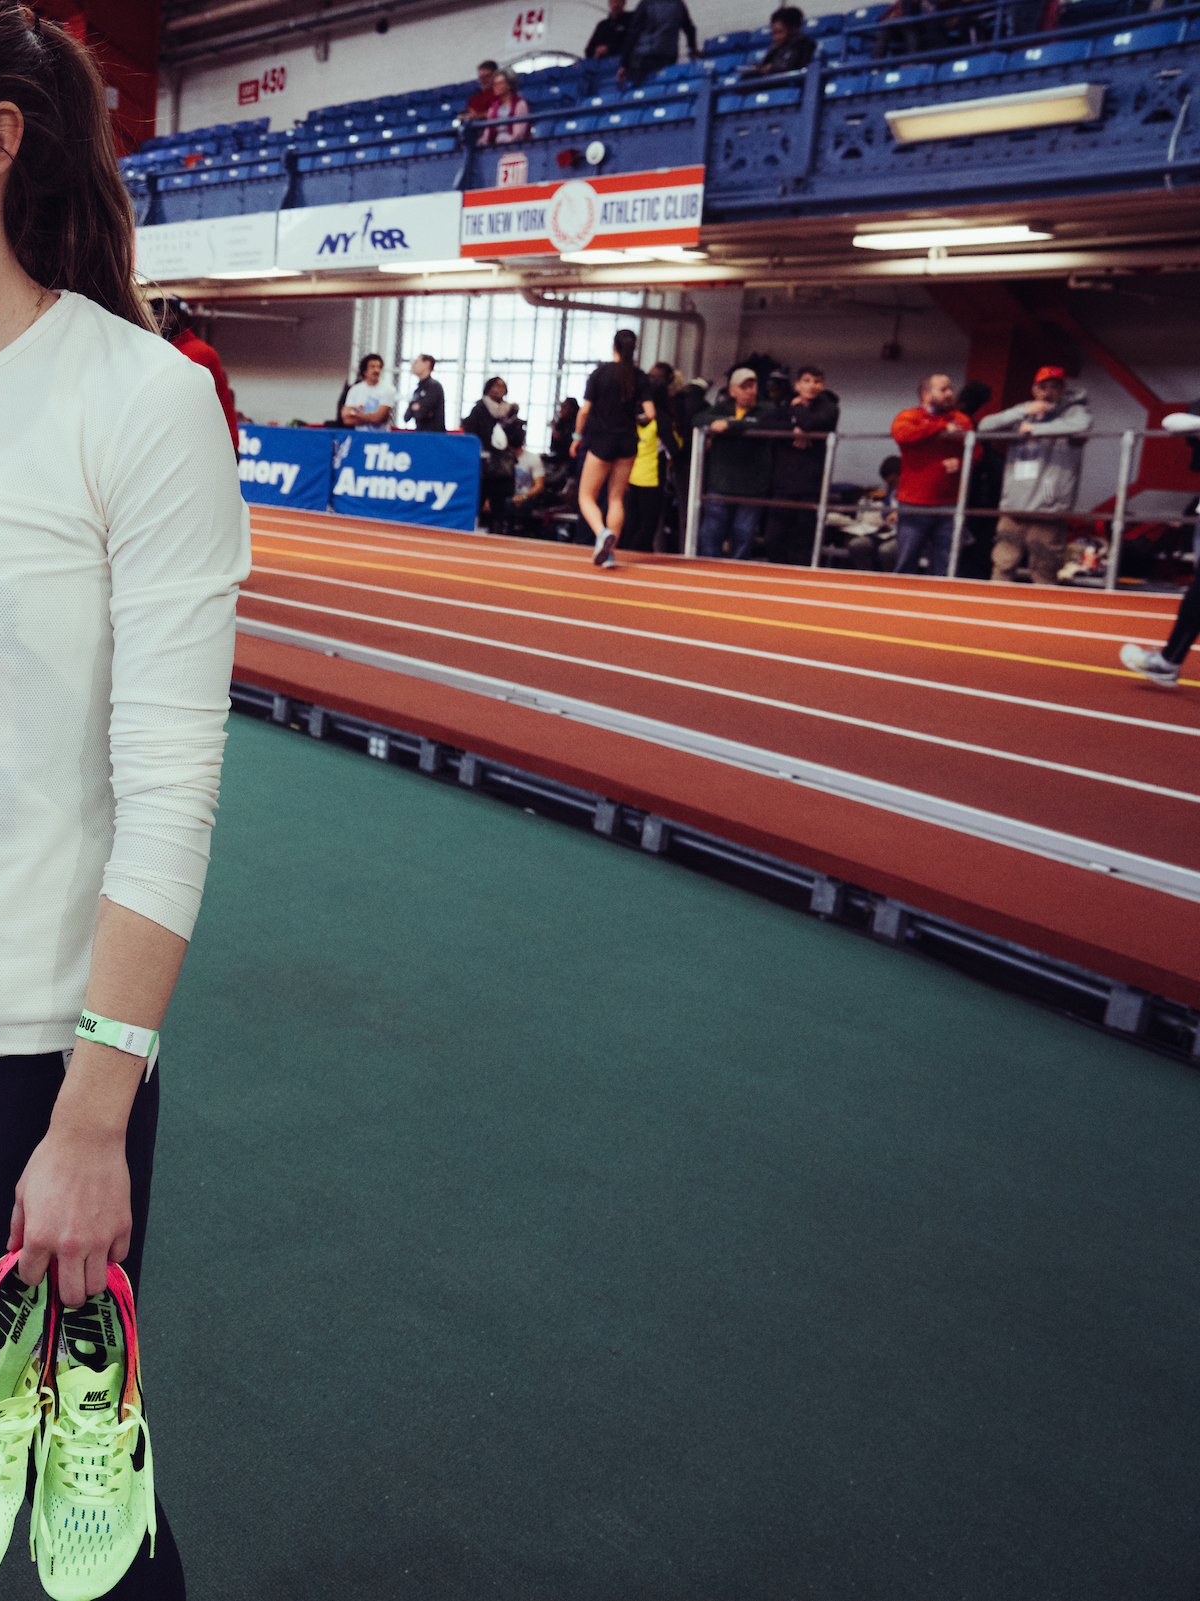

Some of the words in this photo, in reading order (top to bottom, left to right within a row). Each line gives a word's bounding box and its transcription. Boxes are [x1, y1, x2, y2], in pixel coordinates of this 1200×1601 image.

[261, 67, 287, 94] 450
[465, 214, 485, 236] THE
[486, 211, 513, 235] NEW
[516, 208, 547, 232] YORK
[600, 195, 660, 224] ATHLETIC
[664, 193, 699, 221] CLUB
[238, 428, 262, 456] he
[363, 442, 412, 473] The
[238, 458, 301, 495] mory
[332, 466, 459, 511] Armory
[10, 1304, 31, 1345] DISTANCE
[100, 1308, 117, 1348] DISTANCE
[83, 1389, 110, 1402] NIKE
